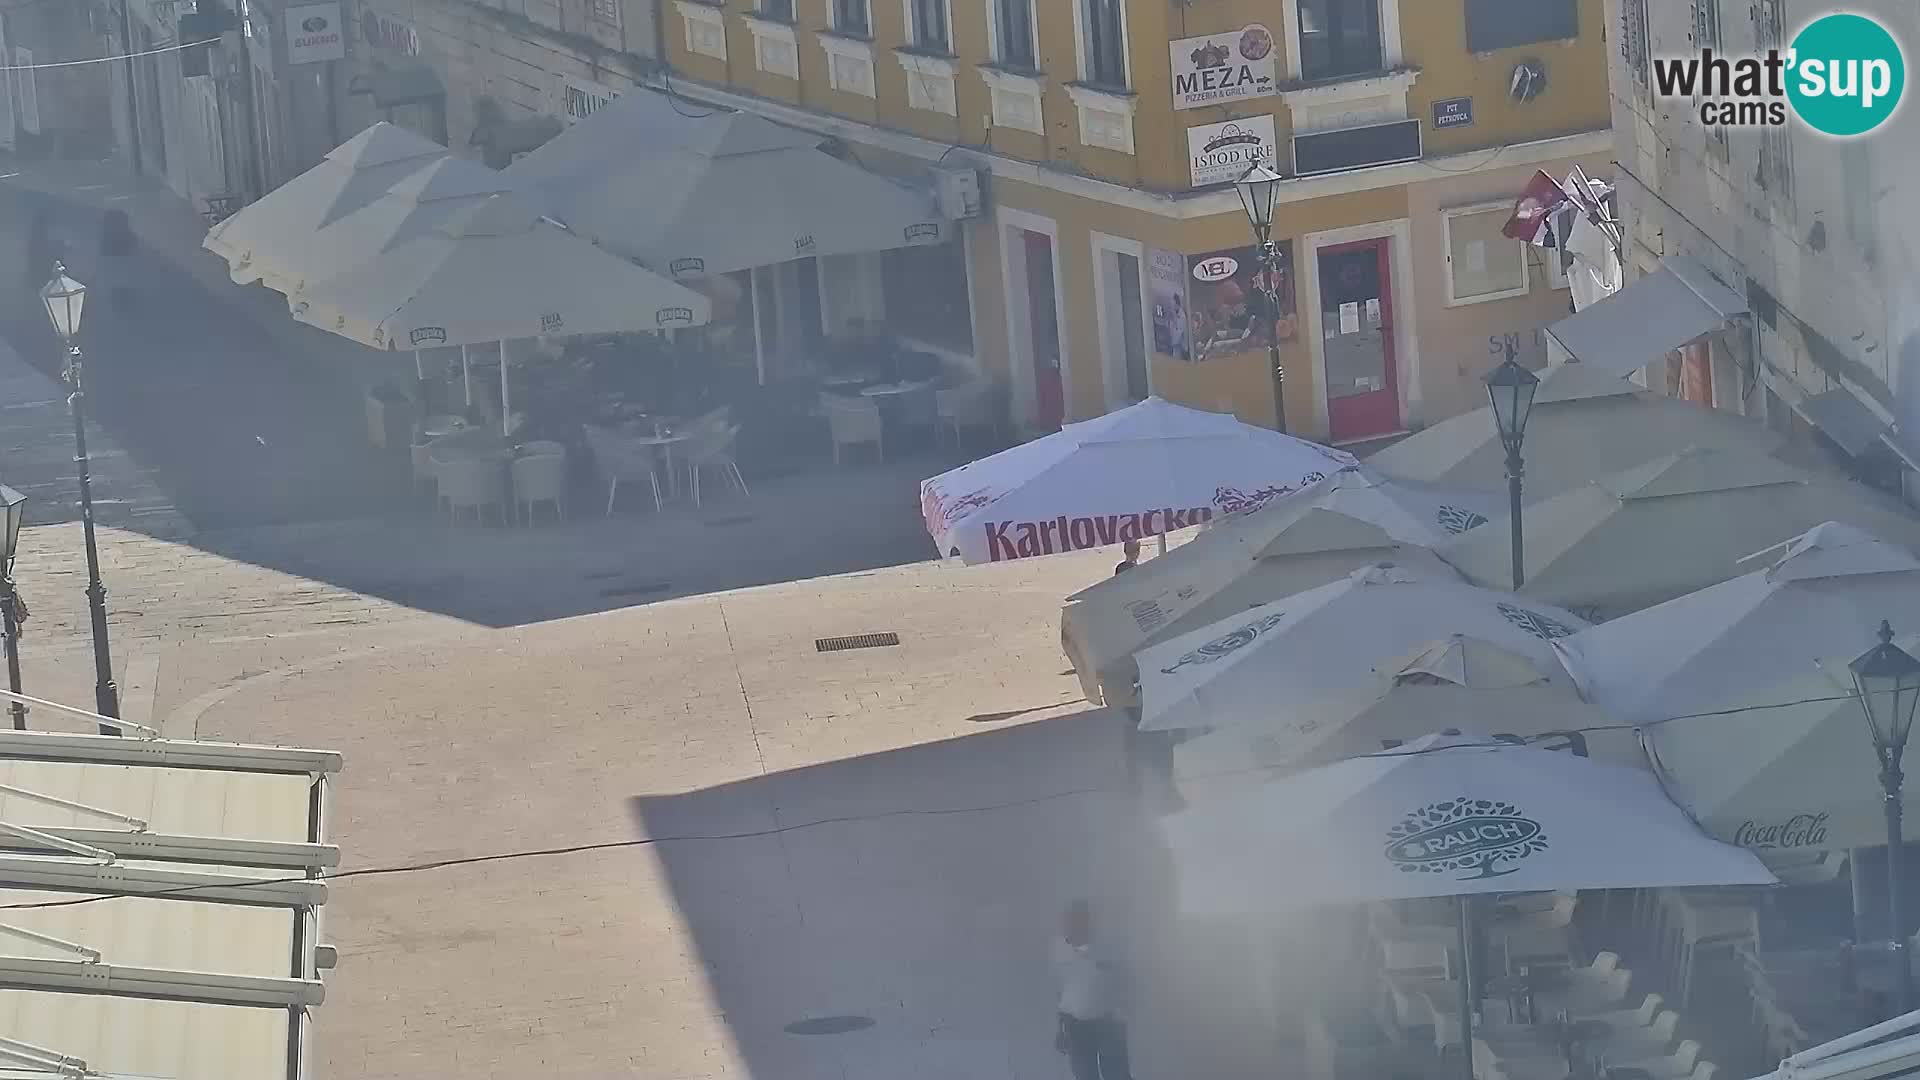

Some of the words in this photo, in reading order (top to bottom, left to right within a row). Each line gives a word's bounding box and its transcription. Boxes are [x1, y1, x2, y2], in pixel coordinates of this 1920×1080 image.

[1175, 64, 1255, 95] MEZA
[1185, 89, 1218, 103] PIZZERIA
[1226, 87, 1248, 97] GRILL
[1194, 150, 1240, 168] ISPOD
[1244, 145, 1273, 160] URE
[985, 506, 1211, 562] Karlovačko
[1425, 822, 1523, 853] RAUCH
